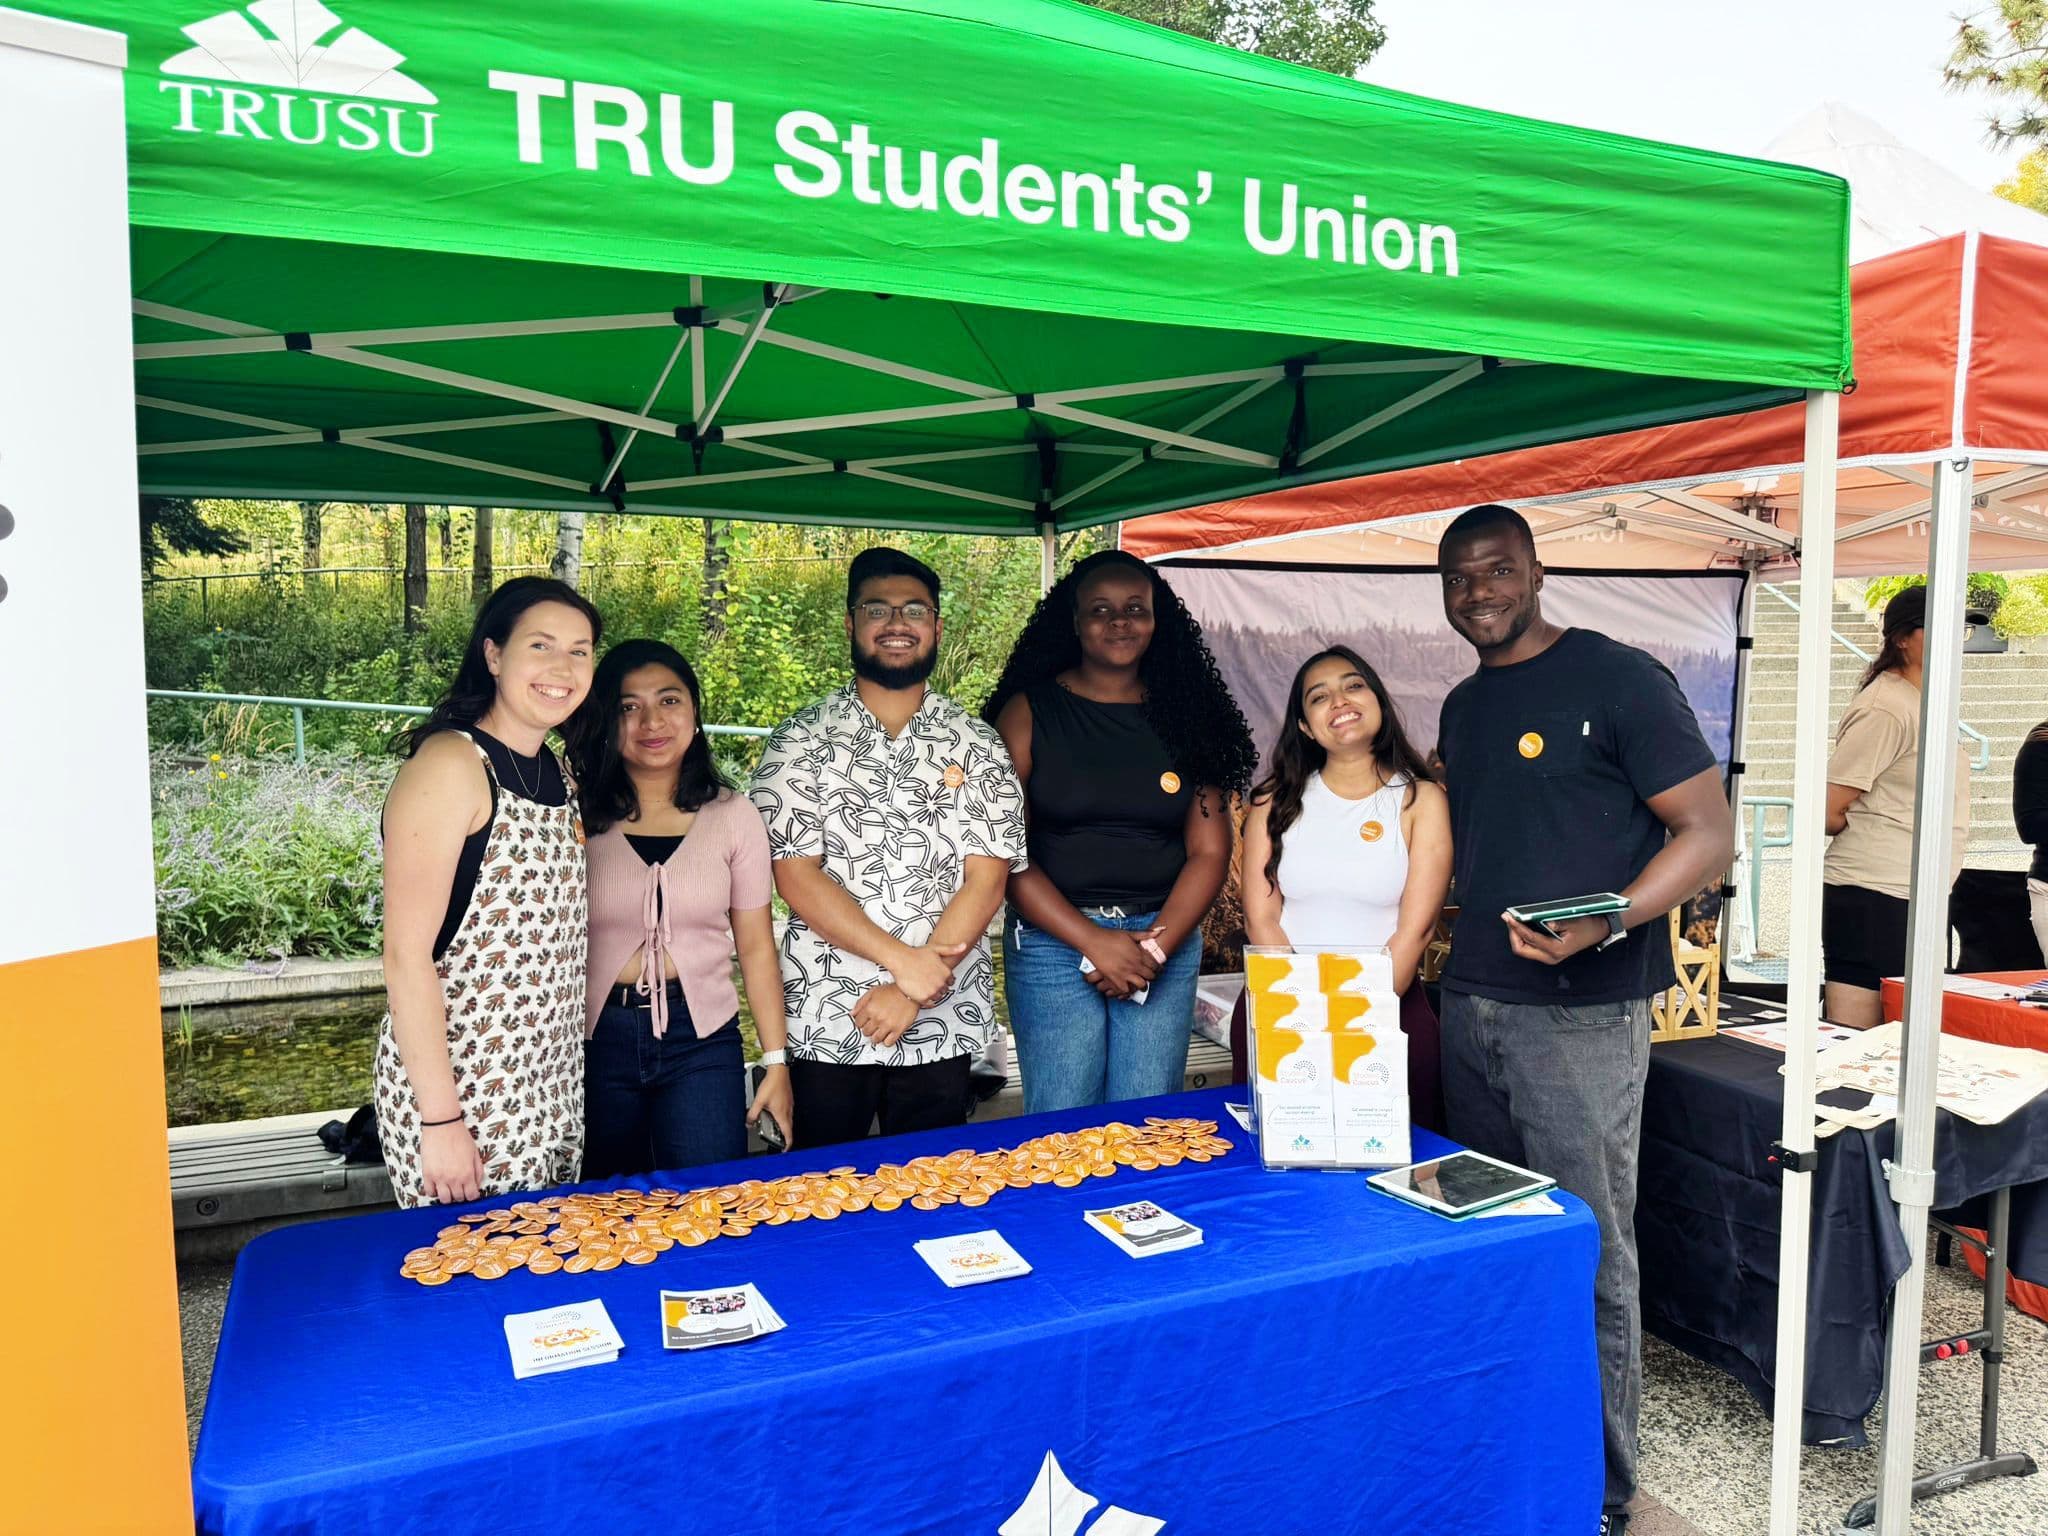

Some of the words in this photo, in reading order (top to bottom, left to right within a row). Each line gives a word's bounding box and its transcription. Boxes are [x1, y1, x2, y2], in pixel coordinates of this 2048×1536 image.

[159, 81, 440, 158] TRUSU
[488, 69, 735, 185] TRU
[774, 110, 1213, 242] Students’
[1244, 177, 1459, 277] Union
